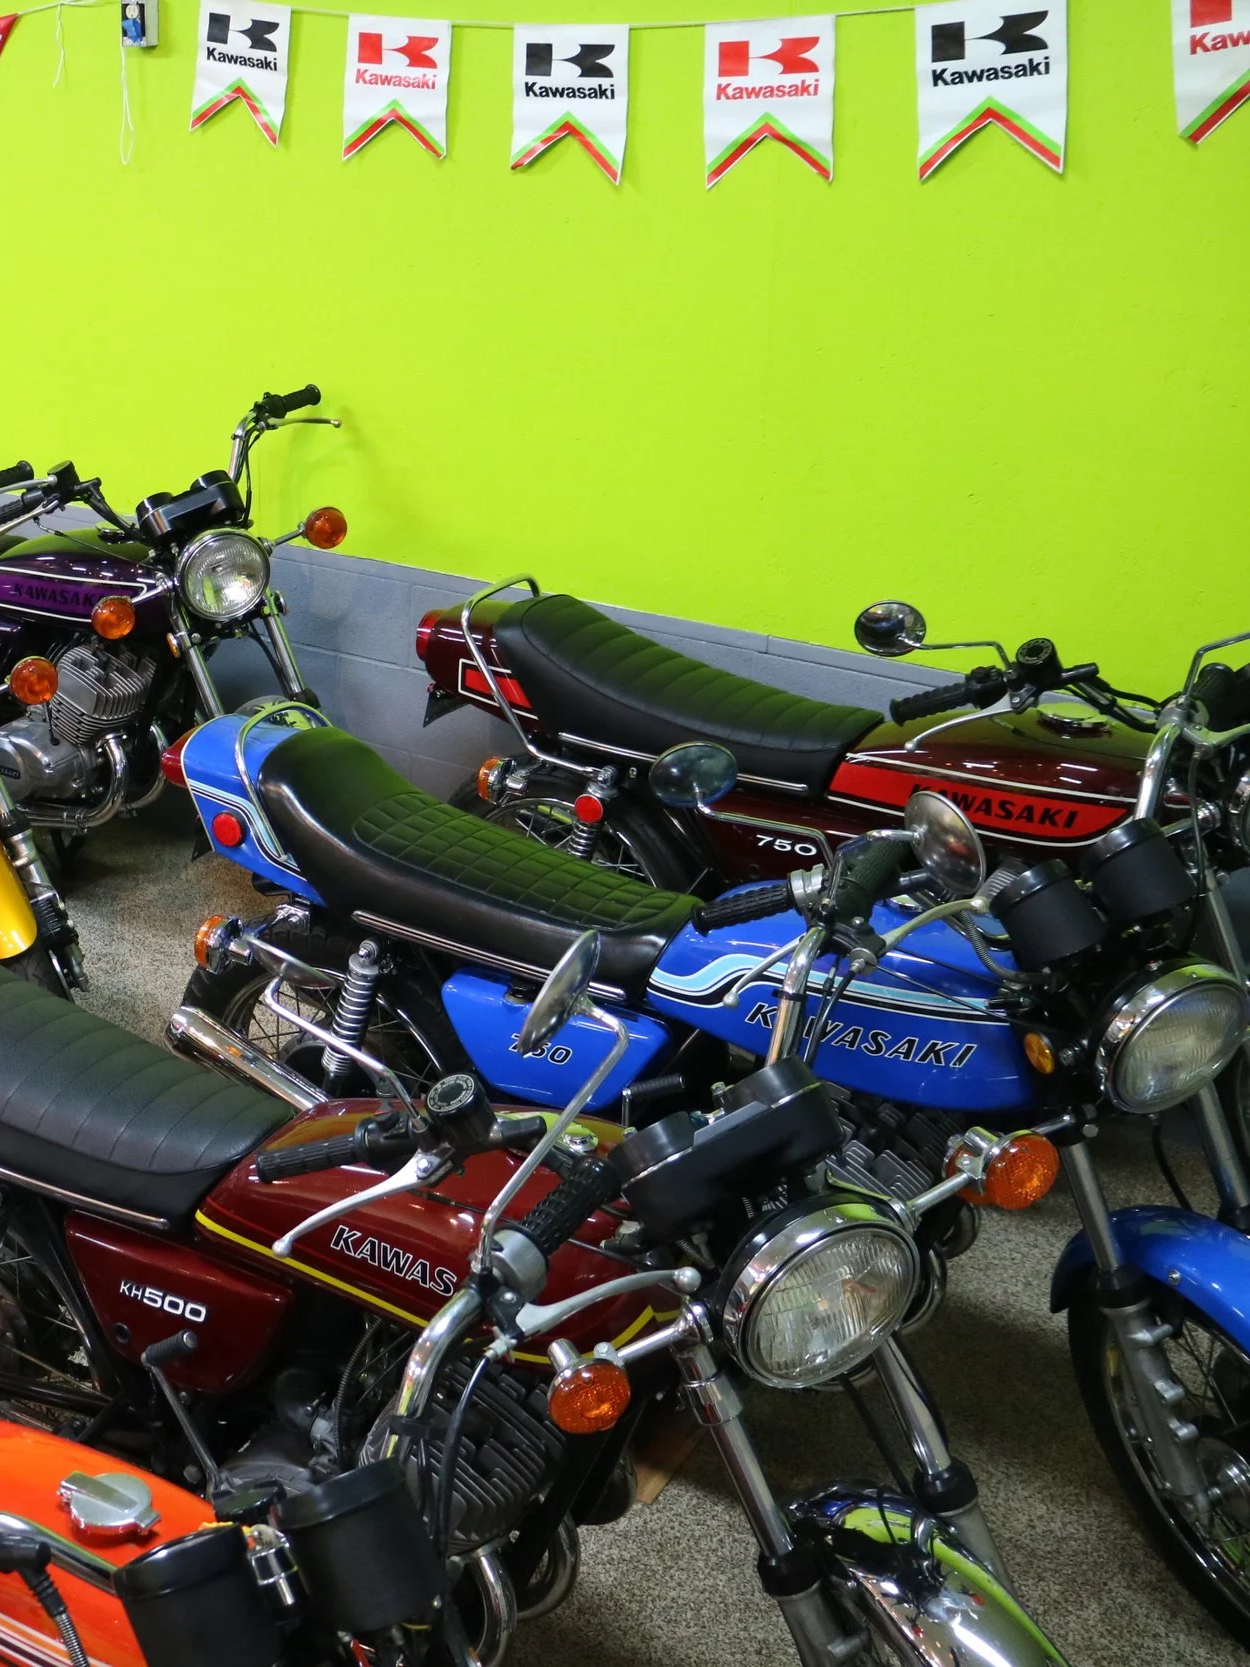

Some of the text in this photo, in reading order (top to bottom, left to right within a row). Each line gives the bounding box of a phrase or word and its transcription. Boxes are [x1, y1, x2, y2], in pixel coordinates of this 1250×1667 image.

[207, 46, 278, 72] Kawasaki
[932, 55, 1050, 87] Kawasaki
[355, 66, 437, 90] Kawasaki
[524, 81, 615, 100] Kawasaki
[716, 79, 819, 100] Kawasaki
[13, 583, 104, 607] KAWASAK
[909, 784, 1078, 829] WASAKI
[756, 834, 817, 856] 750
[745, 1002, 978, 1068] KWASAKI
[119, 1281, 206, 1322] KH500
